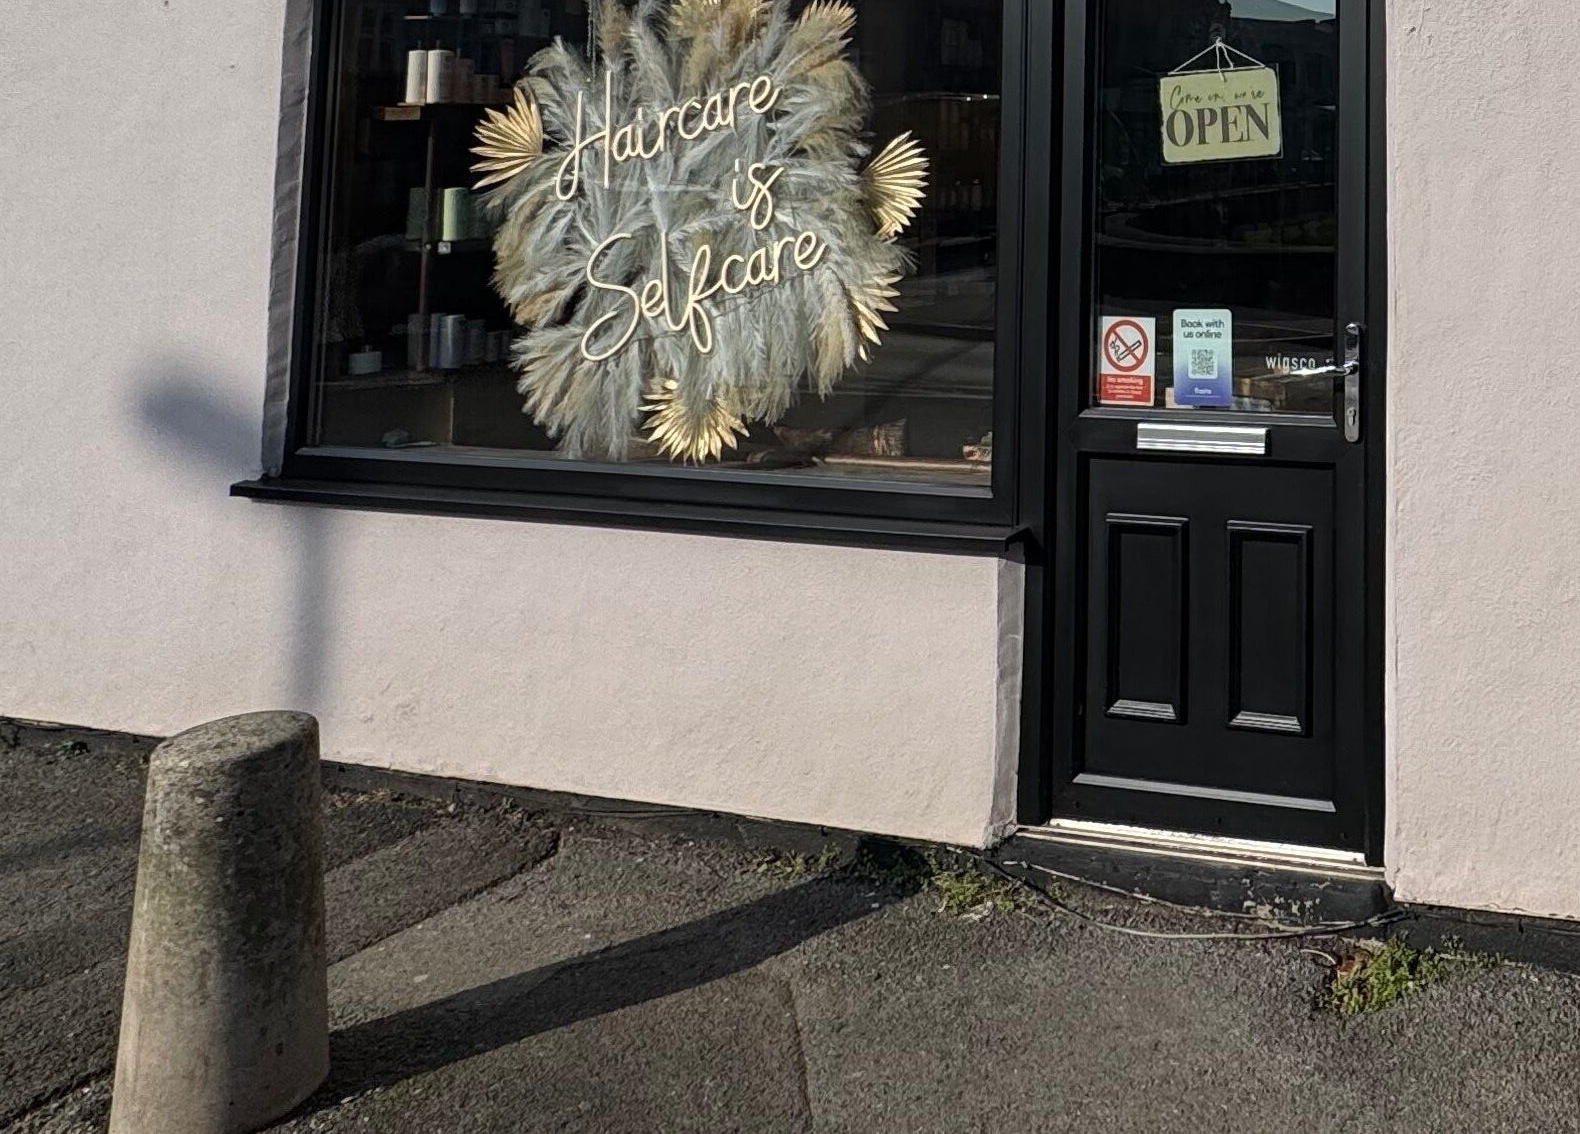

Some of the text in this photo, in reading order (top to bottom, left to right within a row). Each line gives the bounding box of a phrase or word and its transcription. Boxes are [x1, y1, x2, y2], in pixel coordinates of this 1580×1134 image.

[555, 69, 782, 202] Haircare
[1166, 103, 1270, 147] OPEN
[731, 158, 784, 231] is
[579, 230, 827, 362] Selfcare
[1180, 318, 1225, 328] Book with
[1195, 330, 1222, 339] online
